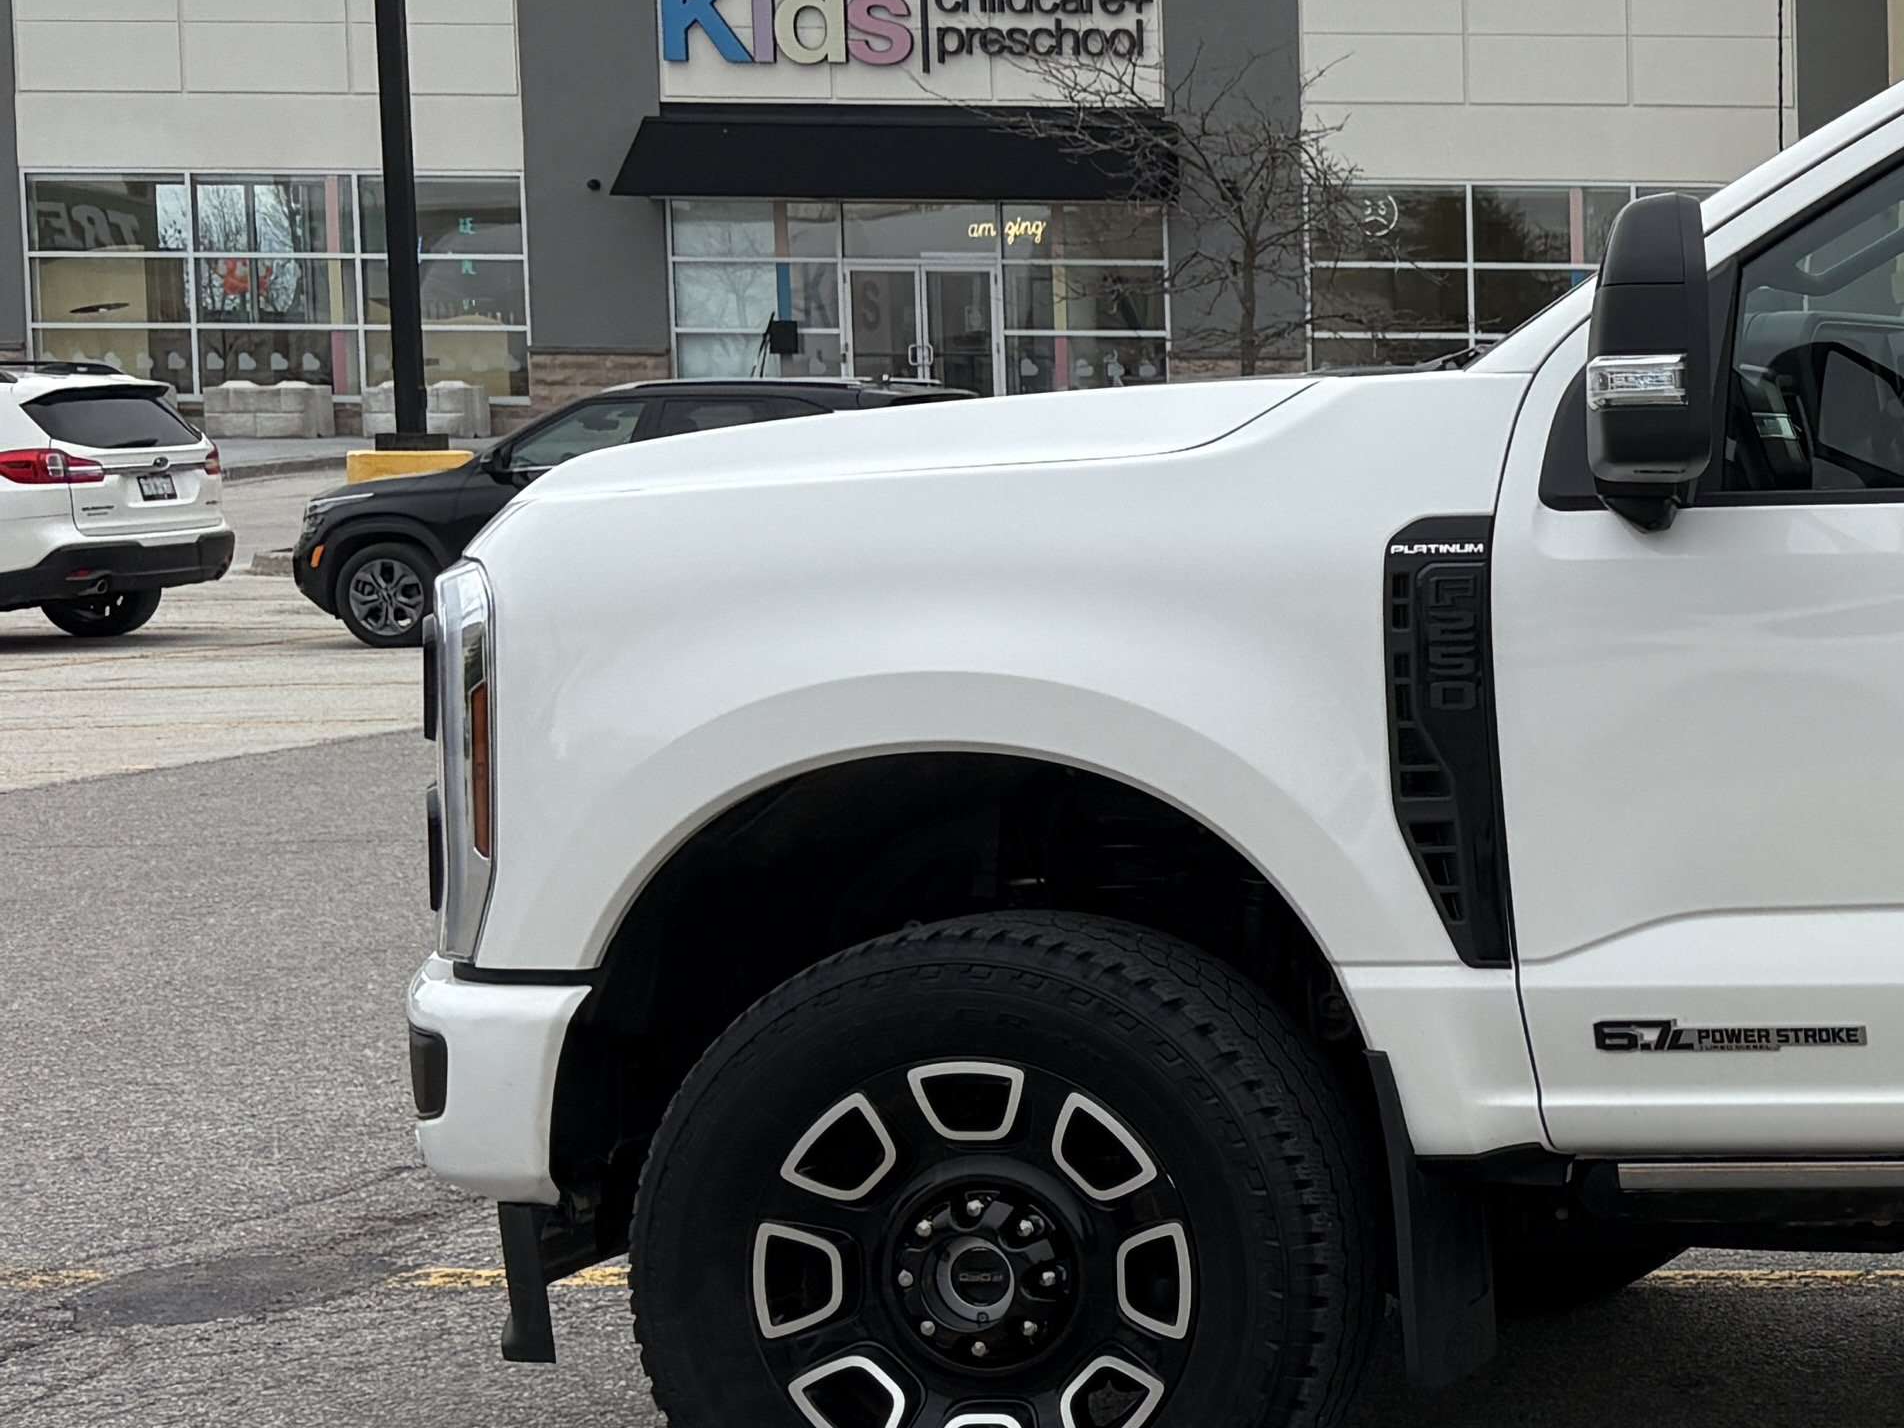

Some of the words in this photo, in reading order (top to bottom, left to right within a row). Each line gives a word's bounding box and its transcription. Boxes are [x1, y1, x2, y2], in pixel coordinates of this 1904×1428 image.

[937, 18, 1145, 64] preschool
[1390, 543, 1484, 554] PLATINUM
[1593, 1018, 1695, 1051] 6.7L
[1697, 1028, 1771, 1044] POWER
[1776, 1027, 1859, 1044] STROKE
